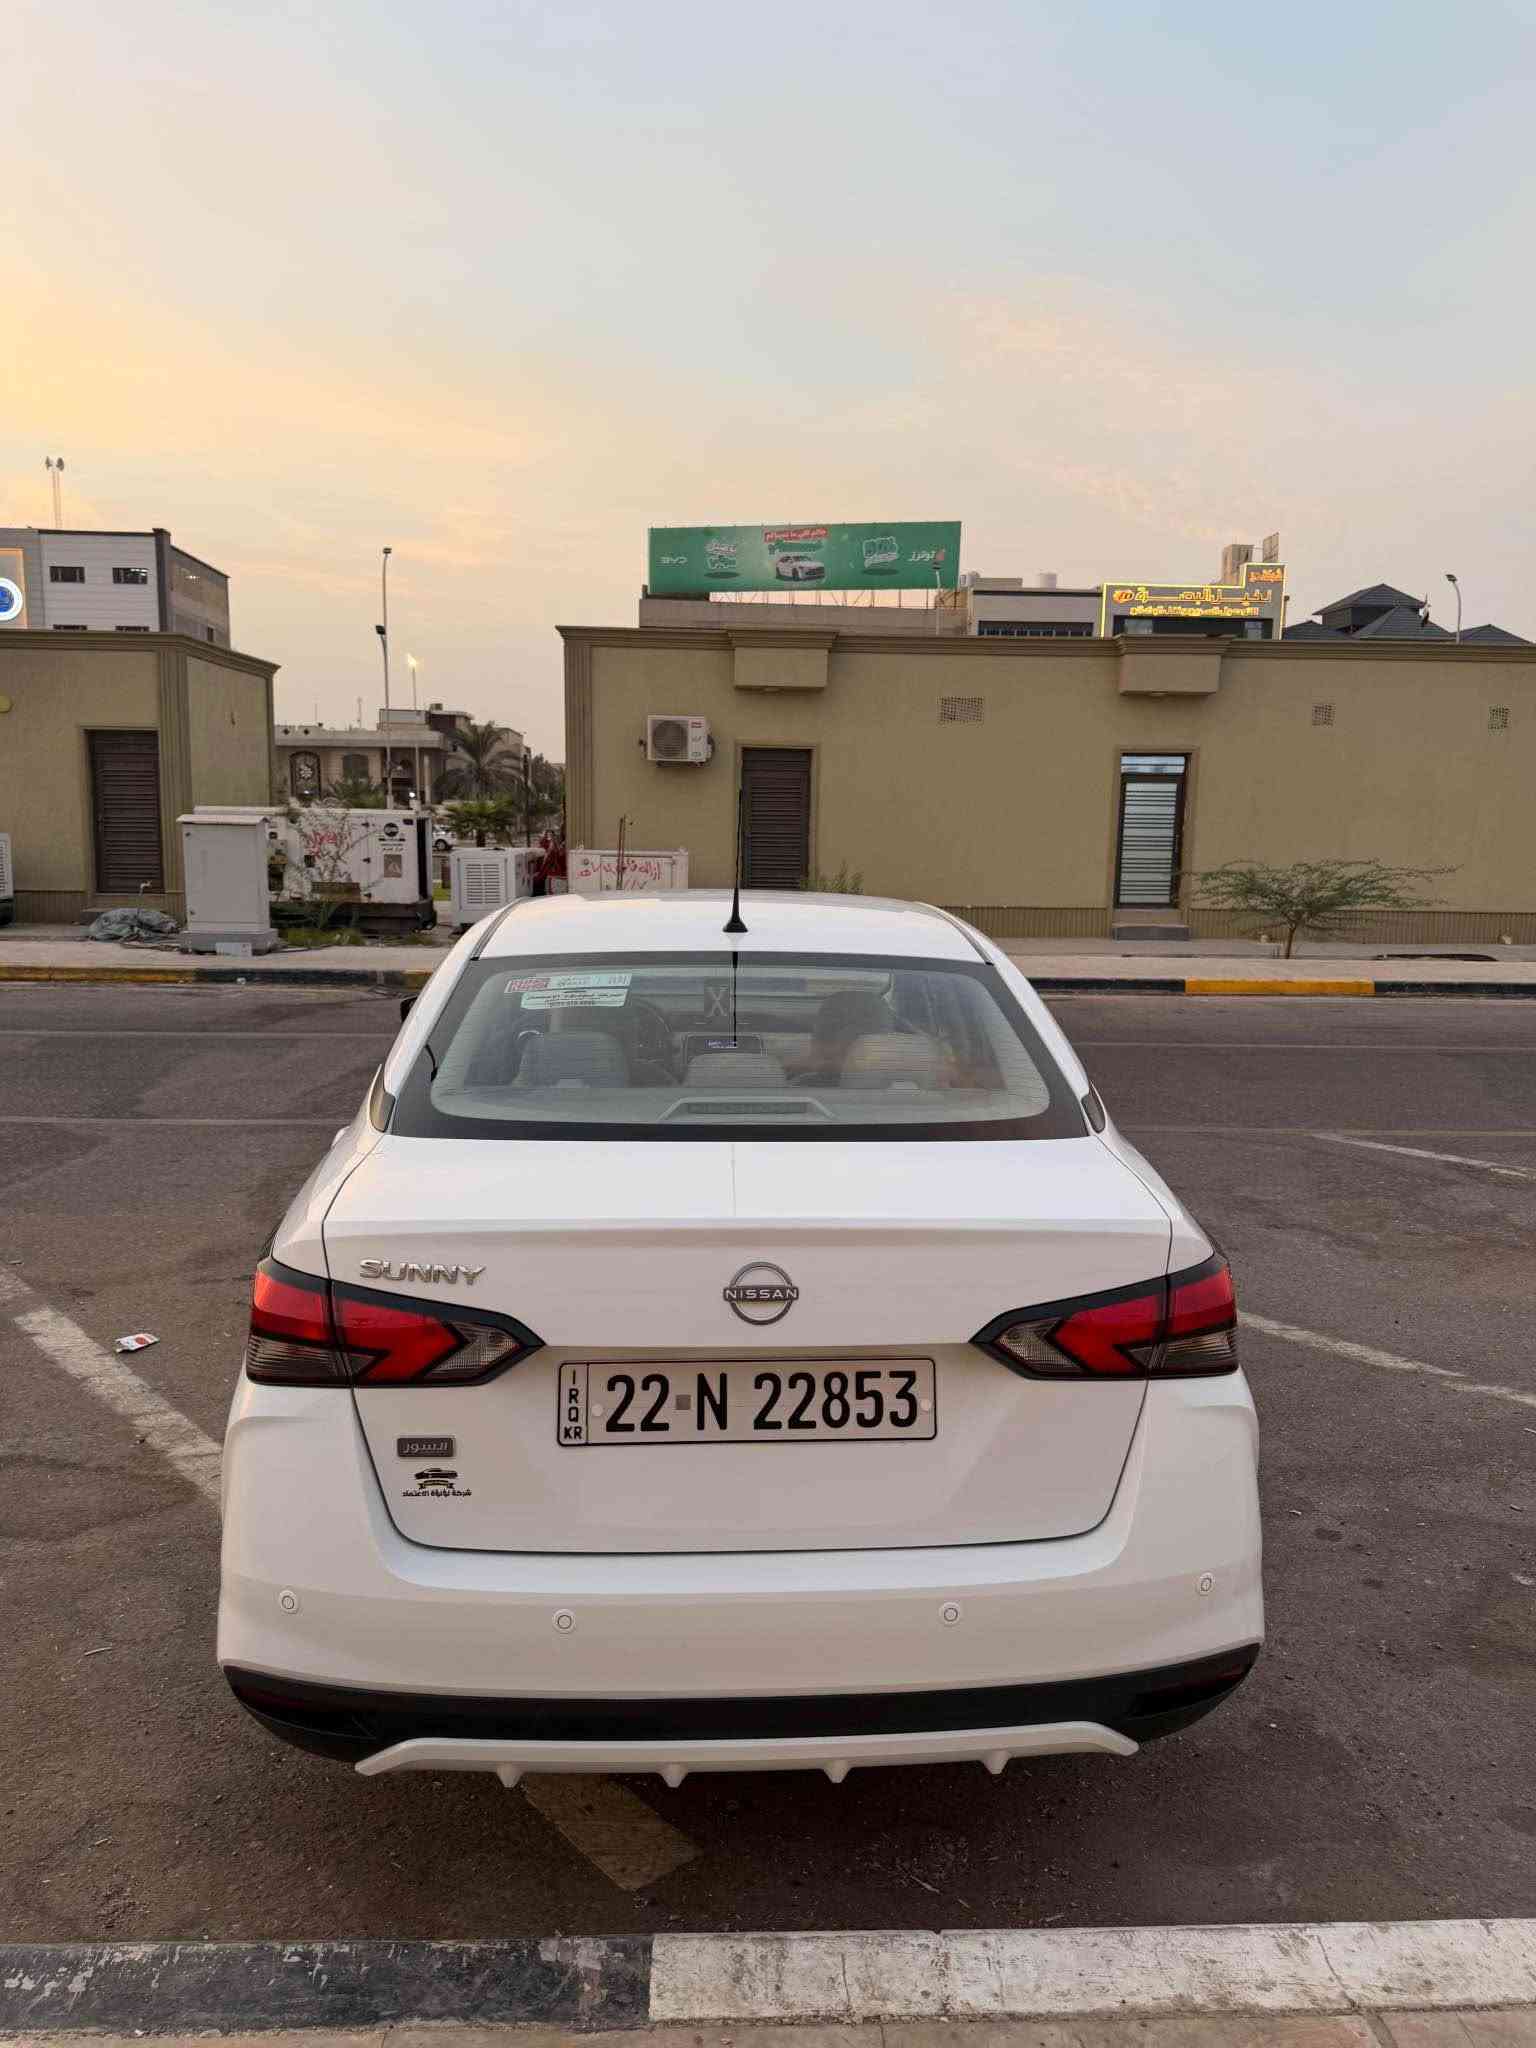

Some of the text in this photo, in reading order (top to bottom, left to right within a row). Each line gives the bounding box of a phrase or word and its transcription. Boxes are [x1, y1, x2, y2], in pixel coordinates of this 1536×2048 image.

[359, 1259, 486, 1286] SUNNY
[725, 1288, 798, 1300] NISSAN
[605, 1370, 918, 1433] 22 N 22853
[564, 1426, 582, 1440] KR
[403, 1442, 449, 1454] السور
